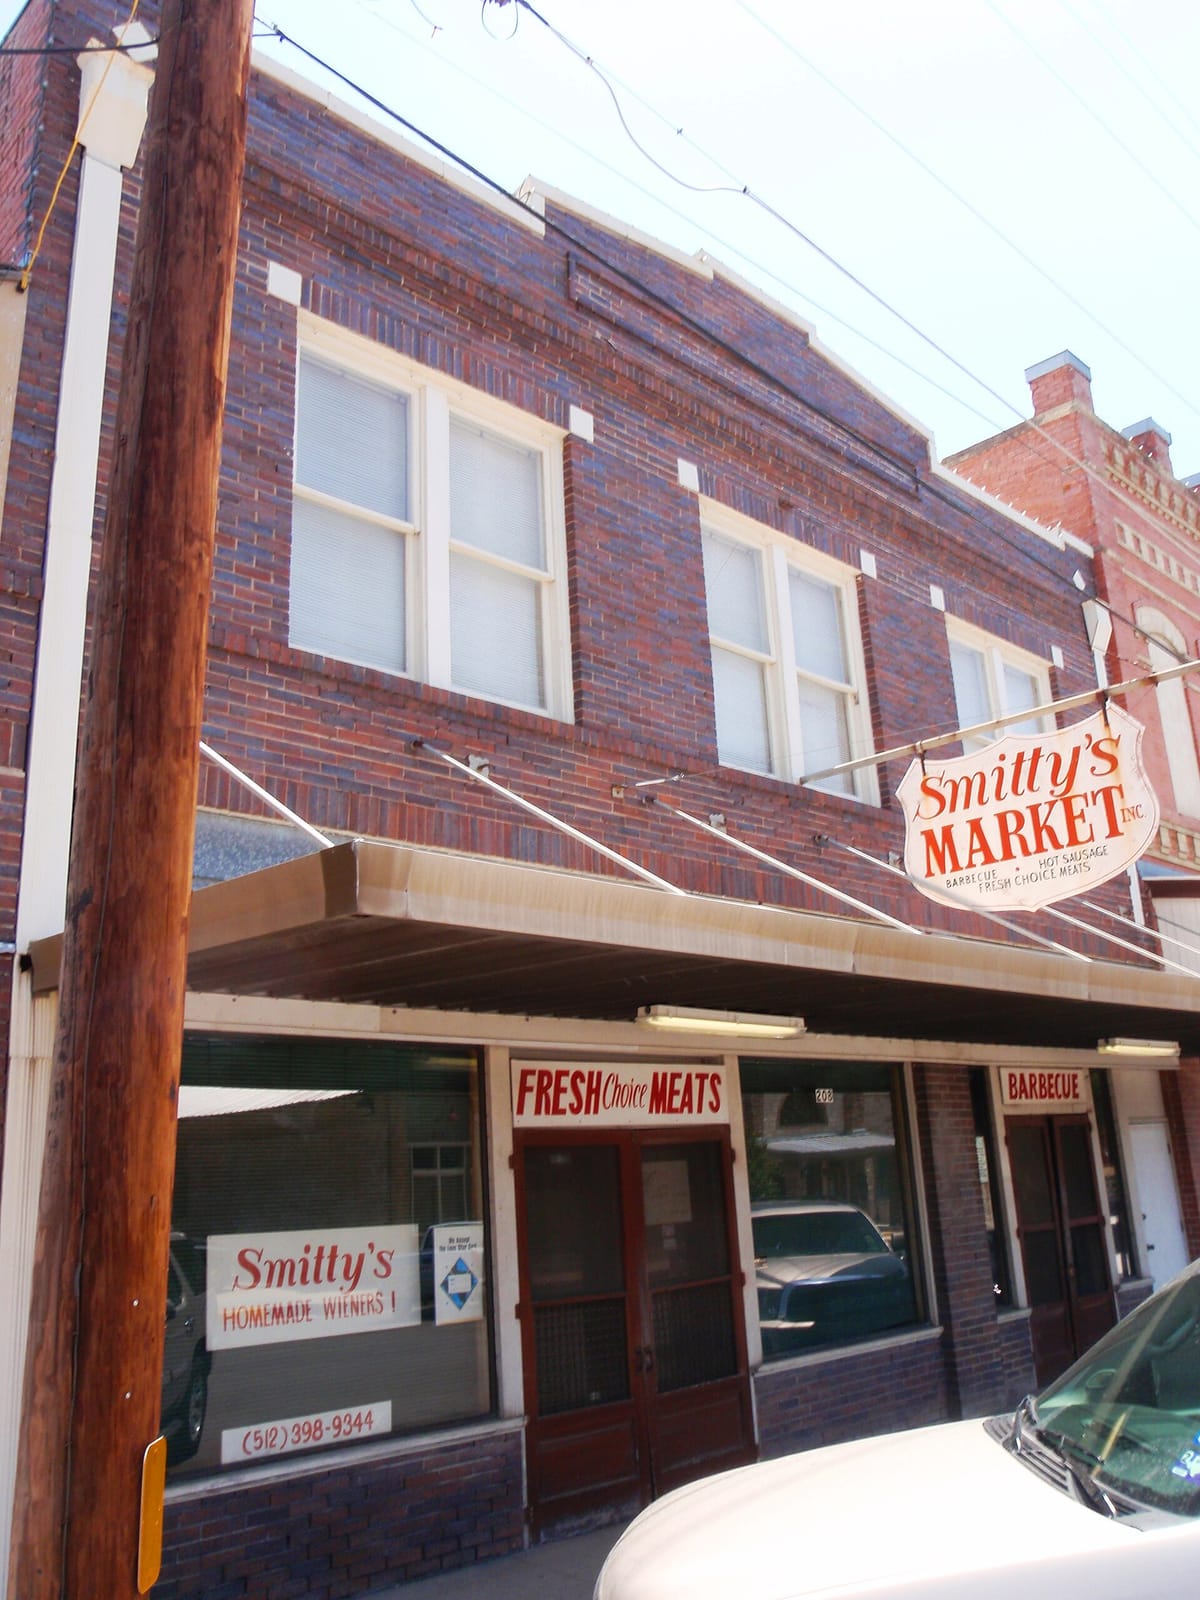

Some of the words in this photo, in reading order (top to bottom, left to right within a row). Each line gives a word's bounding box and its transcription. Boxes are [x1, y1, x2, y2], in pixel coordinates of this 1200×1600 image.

[912, 733, 1121, 822] Smitty's
[920, 784, 1125, 878] MARKET
[1038, 855, 1060, 870] HOT
[1062, 845, 1109, 864] SAUSAGE
[946, 869, 998, 889] BARBECUE
[978, 879, 1012, 894] FRESH
[1014, 869, 1057, 886] CHOICE
[1059, 861, 1091, 878] MEATS
[516, 1068, 602, 1116] FRESH
[602, 1072, 648, 1111] Choice
[648, 1071, 722, 1115] MEATS
[1008, 1073, 1080, 1100] BARBECUE
[232, 1241, 395, 1294] Smitty's
[223, 1299, 312, 1332] HOMEMADE
